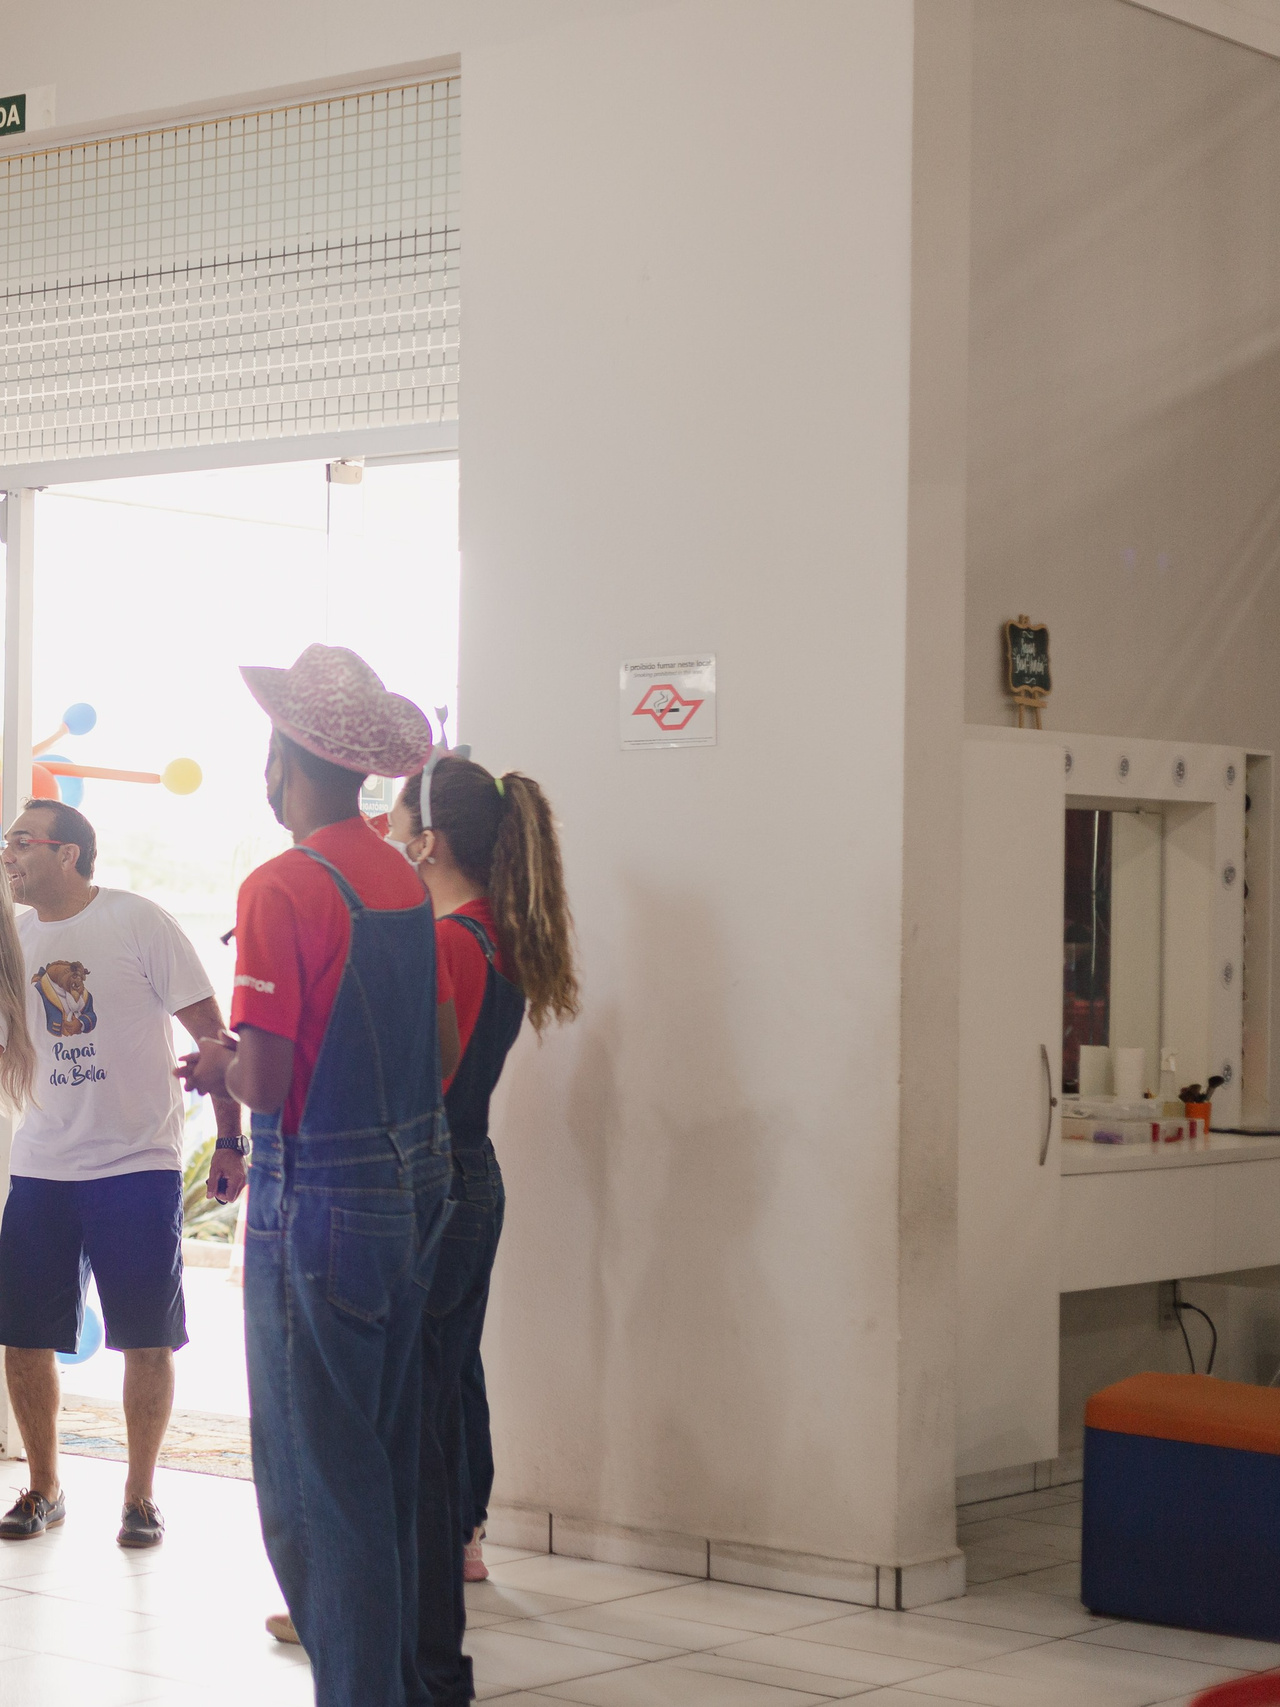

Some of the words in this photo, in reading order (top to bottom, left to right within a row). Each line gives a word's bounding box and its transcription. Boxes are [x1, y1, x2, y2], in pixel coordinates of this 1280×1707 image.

[630, 662, 655, 672] proibido
[52, 1042, 96, 1064] Papai
[49, 1068, 69, 1087] da
[68, 1065, 108, 1086] Bella
